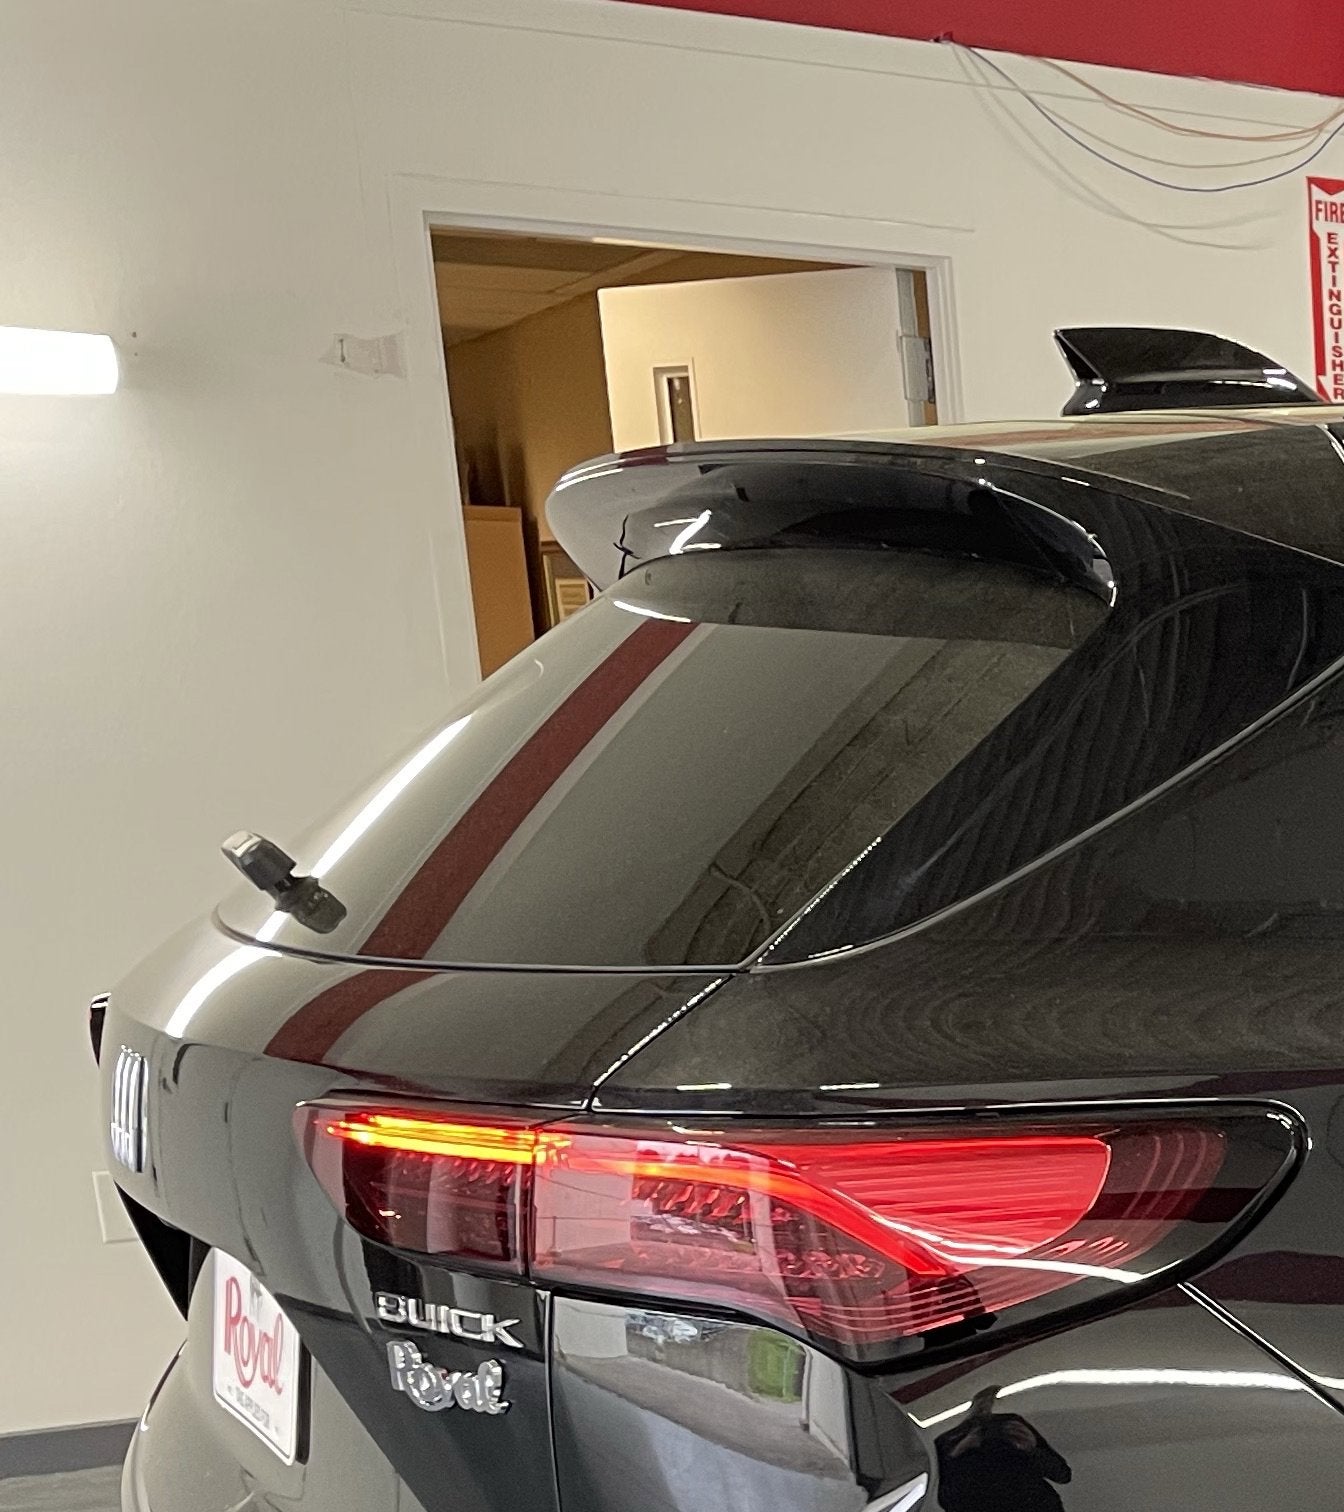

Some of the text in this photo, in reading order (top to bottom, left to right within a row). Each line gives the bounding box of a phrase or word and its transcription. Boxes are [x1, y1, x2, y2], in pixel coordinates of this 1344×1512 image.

[224, 1276, 285, 1396] Royal
[374, 1290, 525, 1349] BUICK
[386, 1338, 511, 1416] Royal
